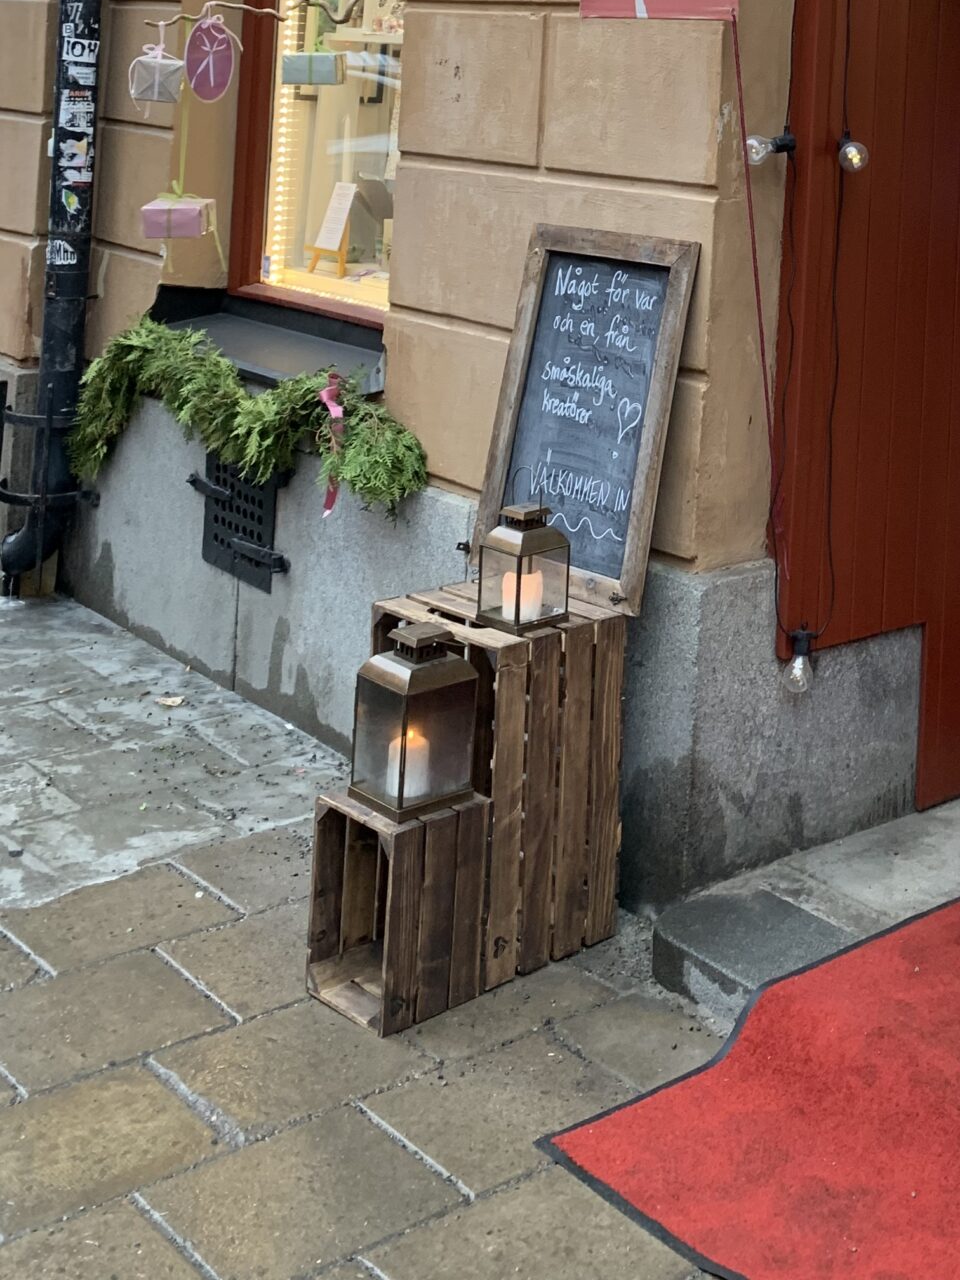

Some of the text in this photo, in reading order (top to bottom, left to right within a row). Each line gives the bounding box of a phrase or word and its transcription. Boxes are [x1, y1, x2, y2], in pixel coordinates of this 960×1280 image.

[554, 265, 600, 310] Något
[605, 270, 630, 307] för
[553, 313, 573, 333] och
[604, 314, 638, 352] från
[540, 356, 618, 406] småskaliga
[530, 448, 631, 513] VÄLKOMMEN IN
